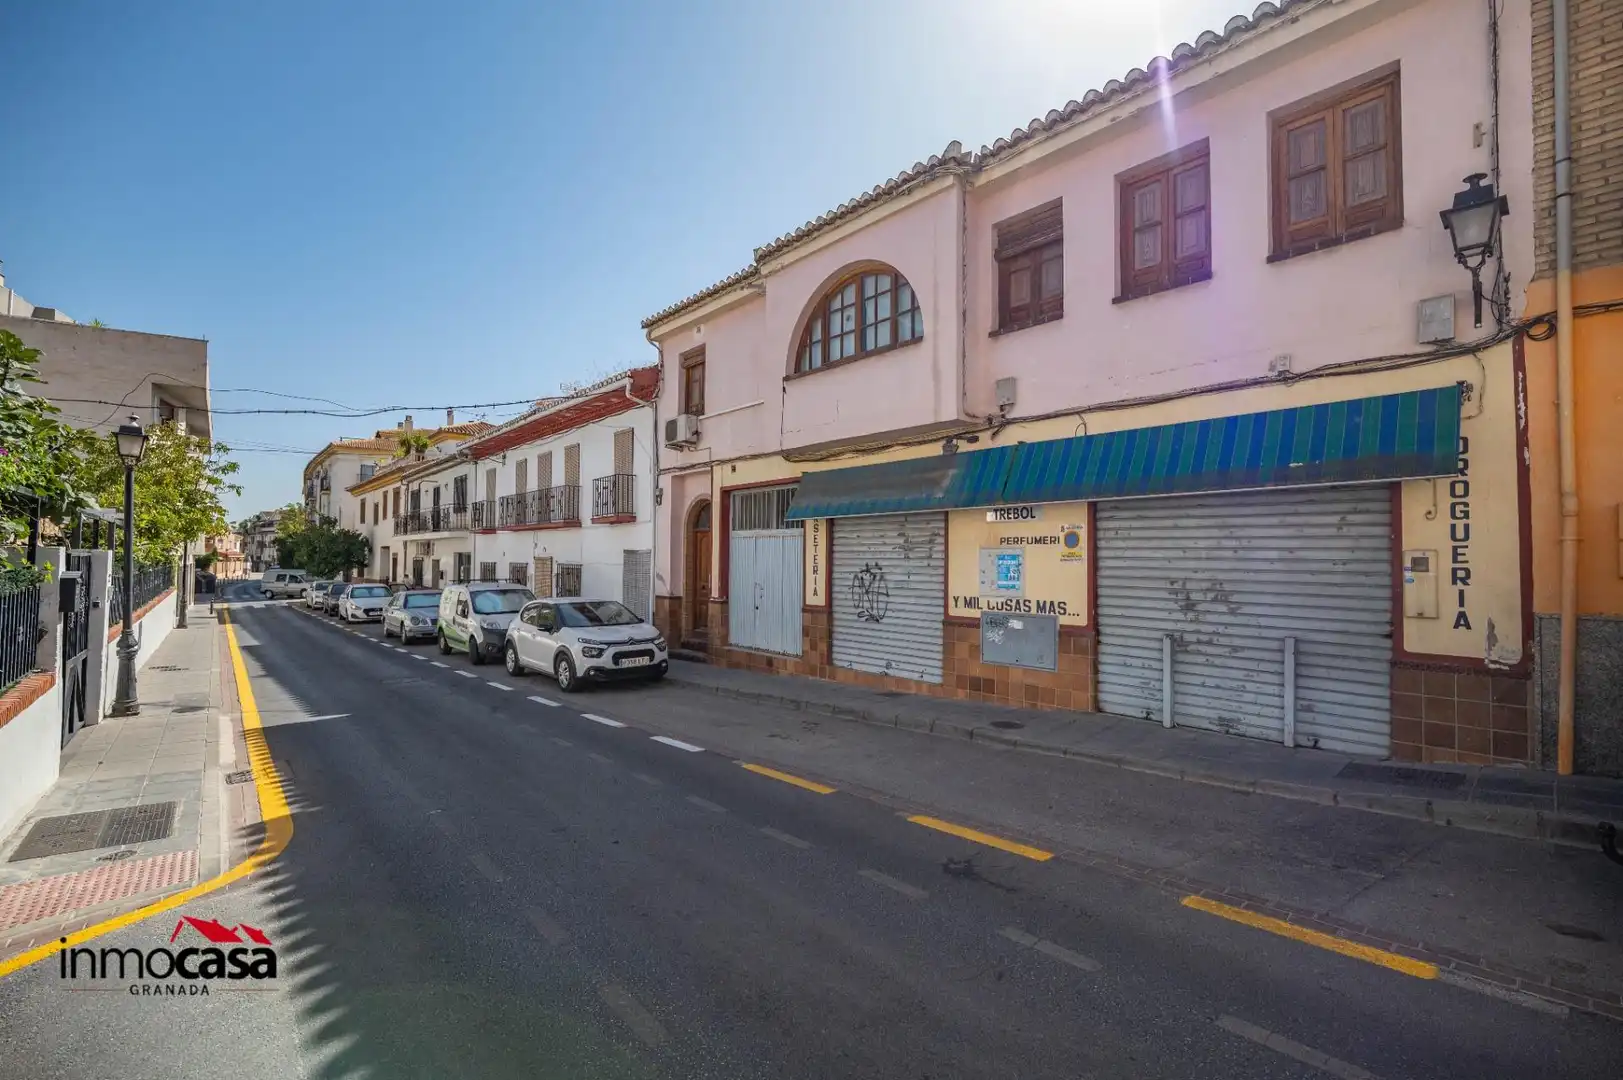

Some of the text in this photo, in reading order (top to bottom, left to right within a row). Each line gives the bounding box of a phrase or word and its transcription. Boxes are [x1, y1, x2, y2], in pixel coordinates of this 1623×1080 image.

[992, 506, 1036, 521] TREBOL
[1000, 535, 1060, 546] PERFUMERI
[952, 596, 960, 609] Y
[963, 596, 983, 610] MIL
